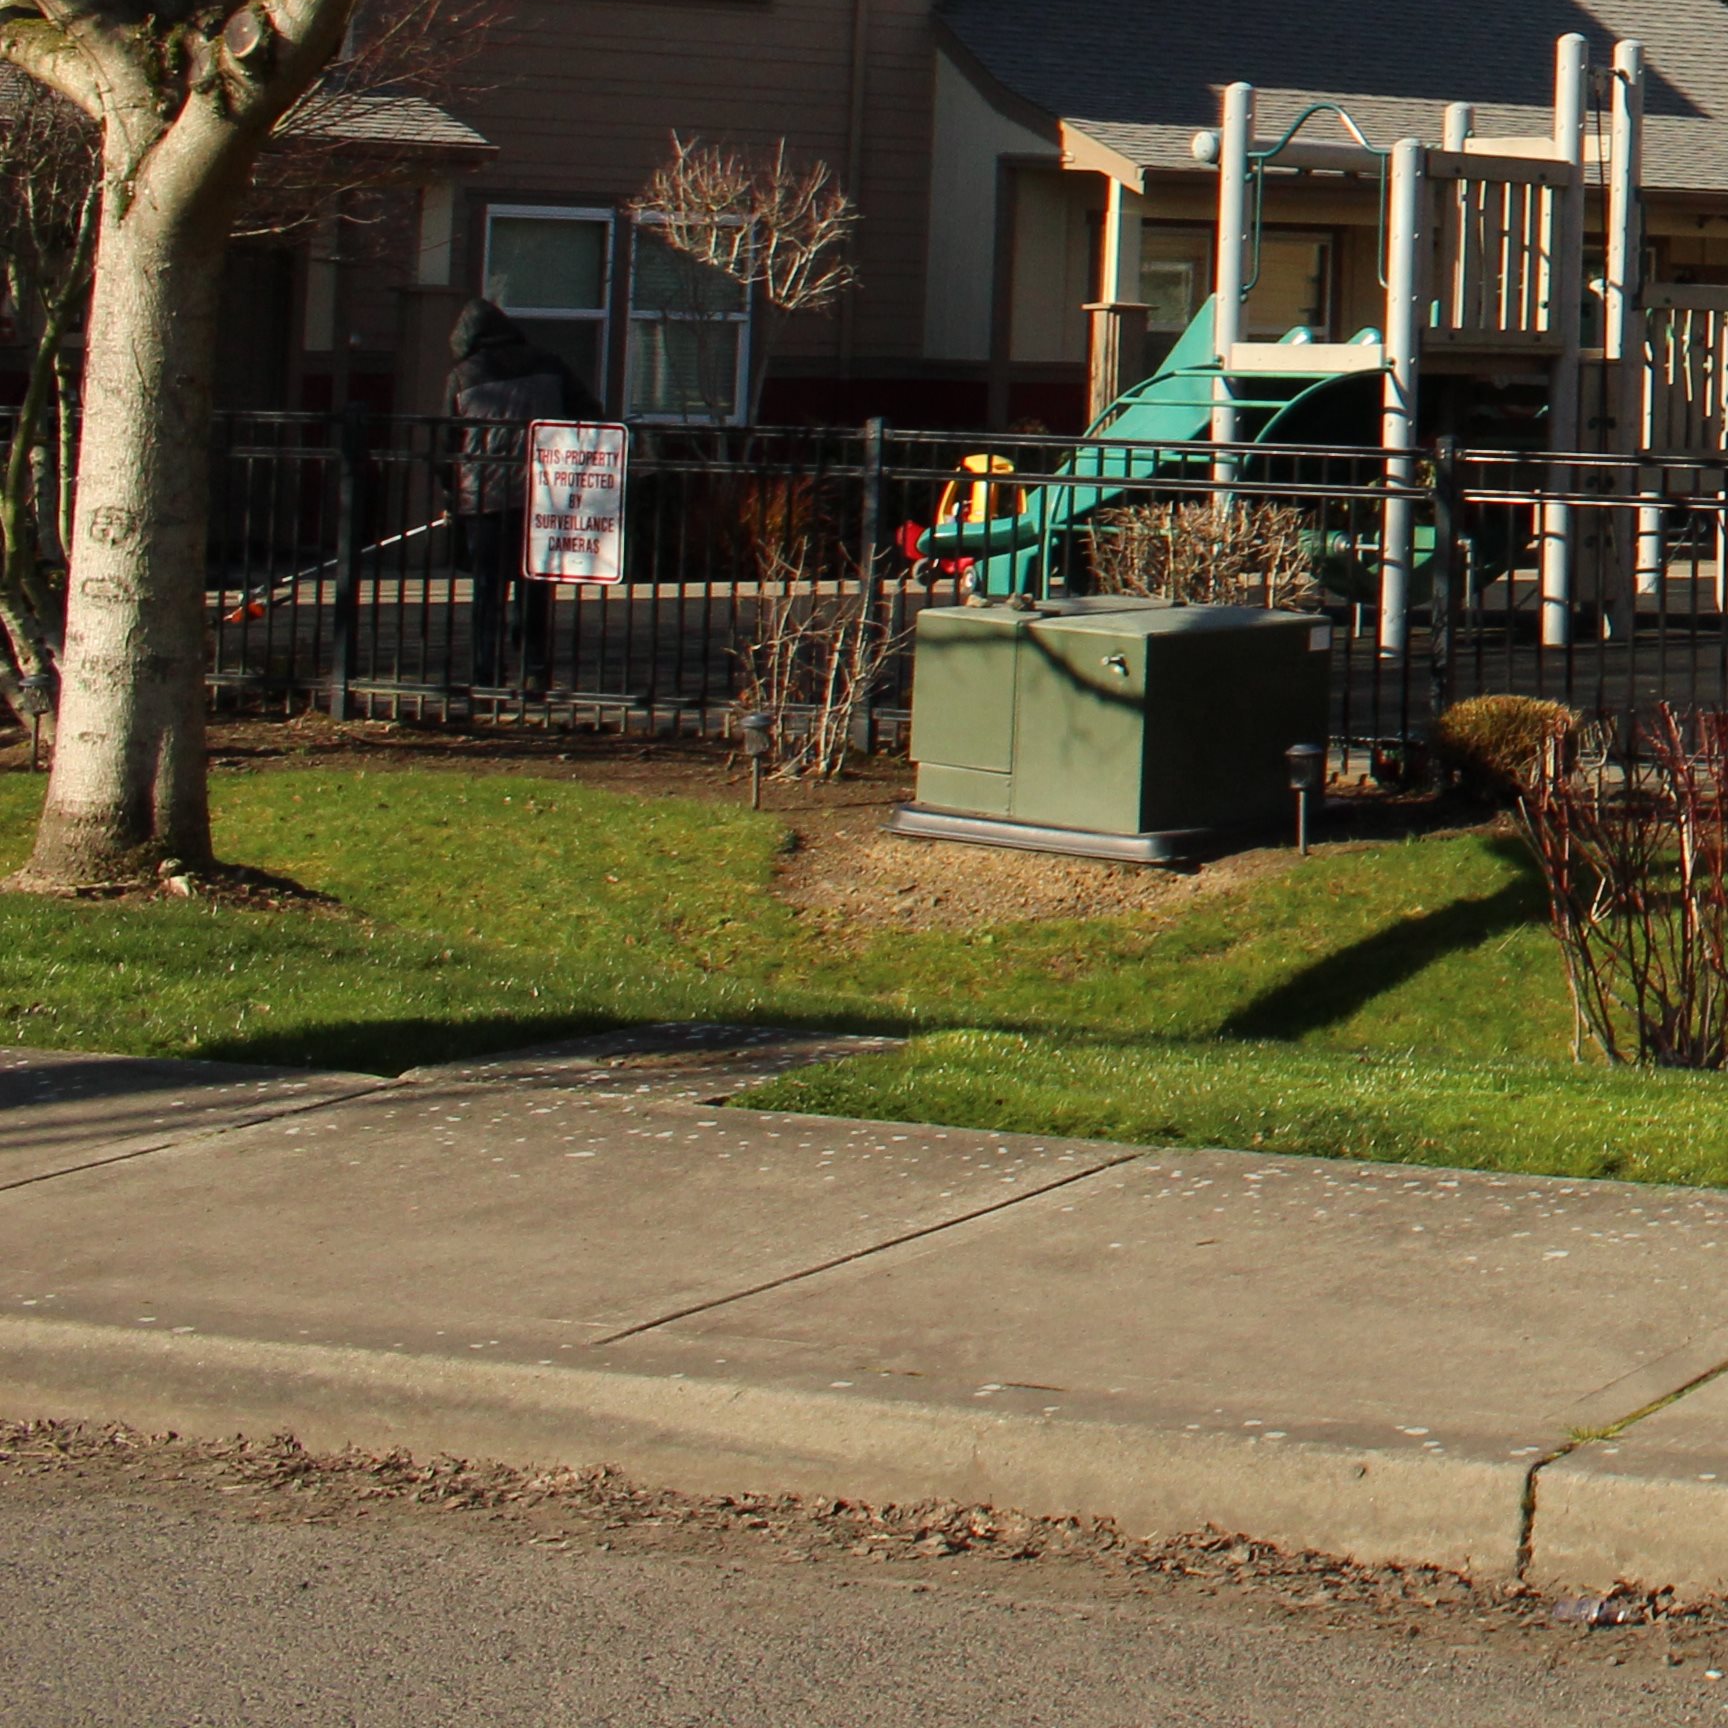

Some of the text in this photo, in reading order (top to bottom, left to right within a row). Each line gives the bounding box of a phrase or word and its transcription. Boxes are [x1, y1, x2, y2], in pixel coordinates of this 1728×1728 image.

[537, 448, 619, 467] THIS PROPERTY
[538, 472, 614, 489] IS PROTECTED
[568, 493, 581, 509] BY
[535, 513, 615, 533] SURVEILLANCE
[549, 536, 600, 554] CAMERAS
